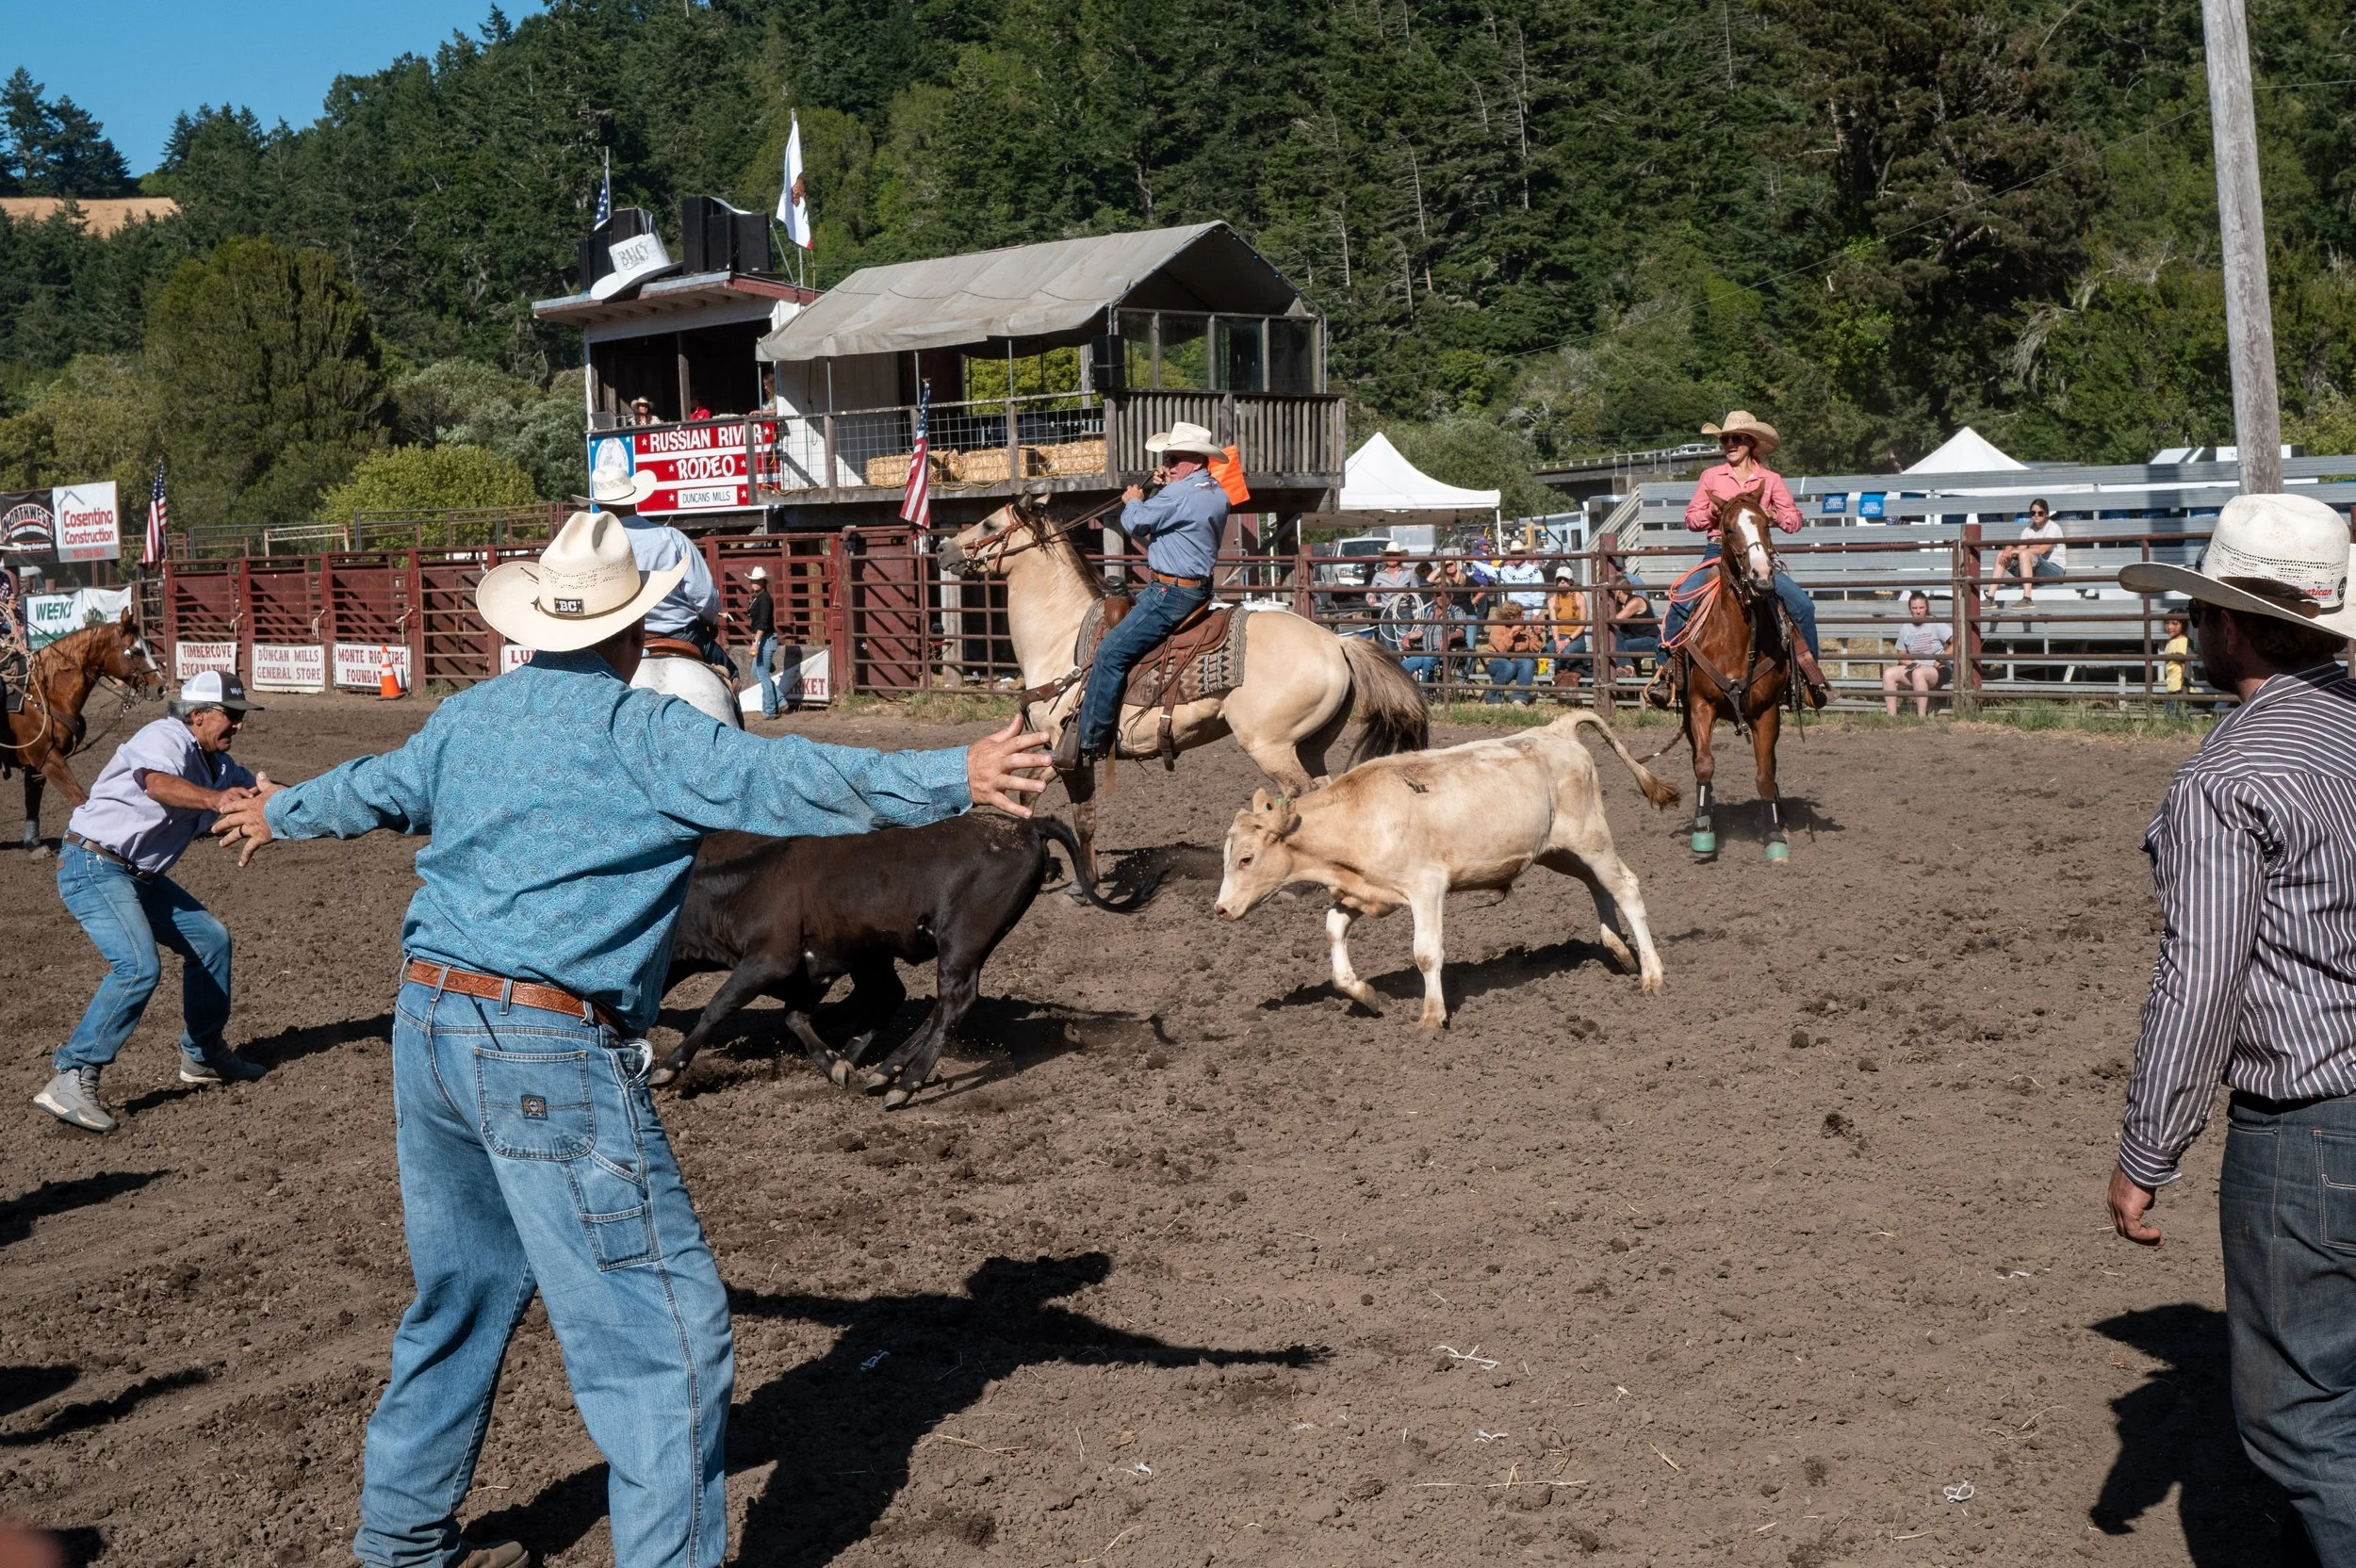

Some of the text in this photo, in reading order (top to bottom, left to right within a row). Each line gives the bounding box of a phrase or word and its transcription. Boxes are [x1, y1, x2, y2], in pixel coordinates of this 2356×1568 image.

[649, 423, 762, 452] RUSSIAN RIVR
[676, 455, 735, 480] RODEO
[682, 490, 730, 504] DUNCANS MILLS
[2, 503, 54, 541] NORTHWEST
[63, 507, 113, 528] Cosentino
[64, 529, 114, 546] Construction
[36, 601, 74, 621] WEEKS
[559, 600, 578, 612] BC
[182, 645, 232, 659] TIMBERCOVE
[258, 648, 319, 662] DUNCAN MILLS
[337, 648, 365, 664] MONTE
[368, 650, 382, 664] RIO
[256, 666, 321, 680] GENERAL STORE
[346, 668, 382, 684] FOUNDAT
[790, 678, 826, 695] RKET
